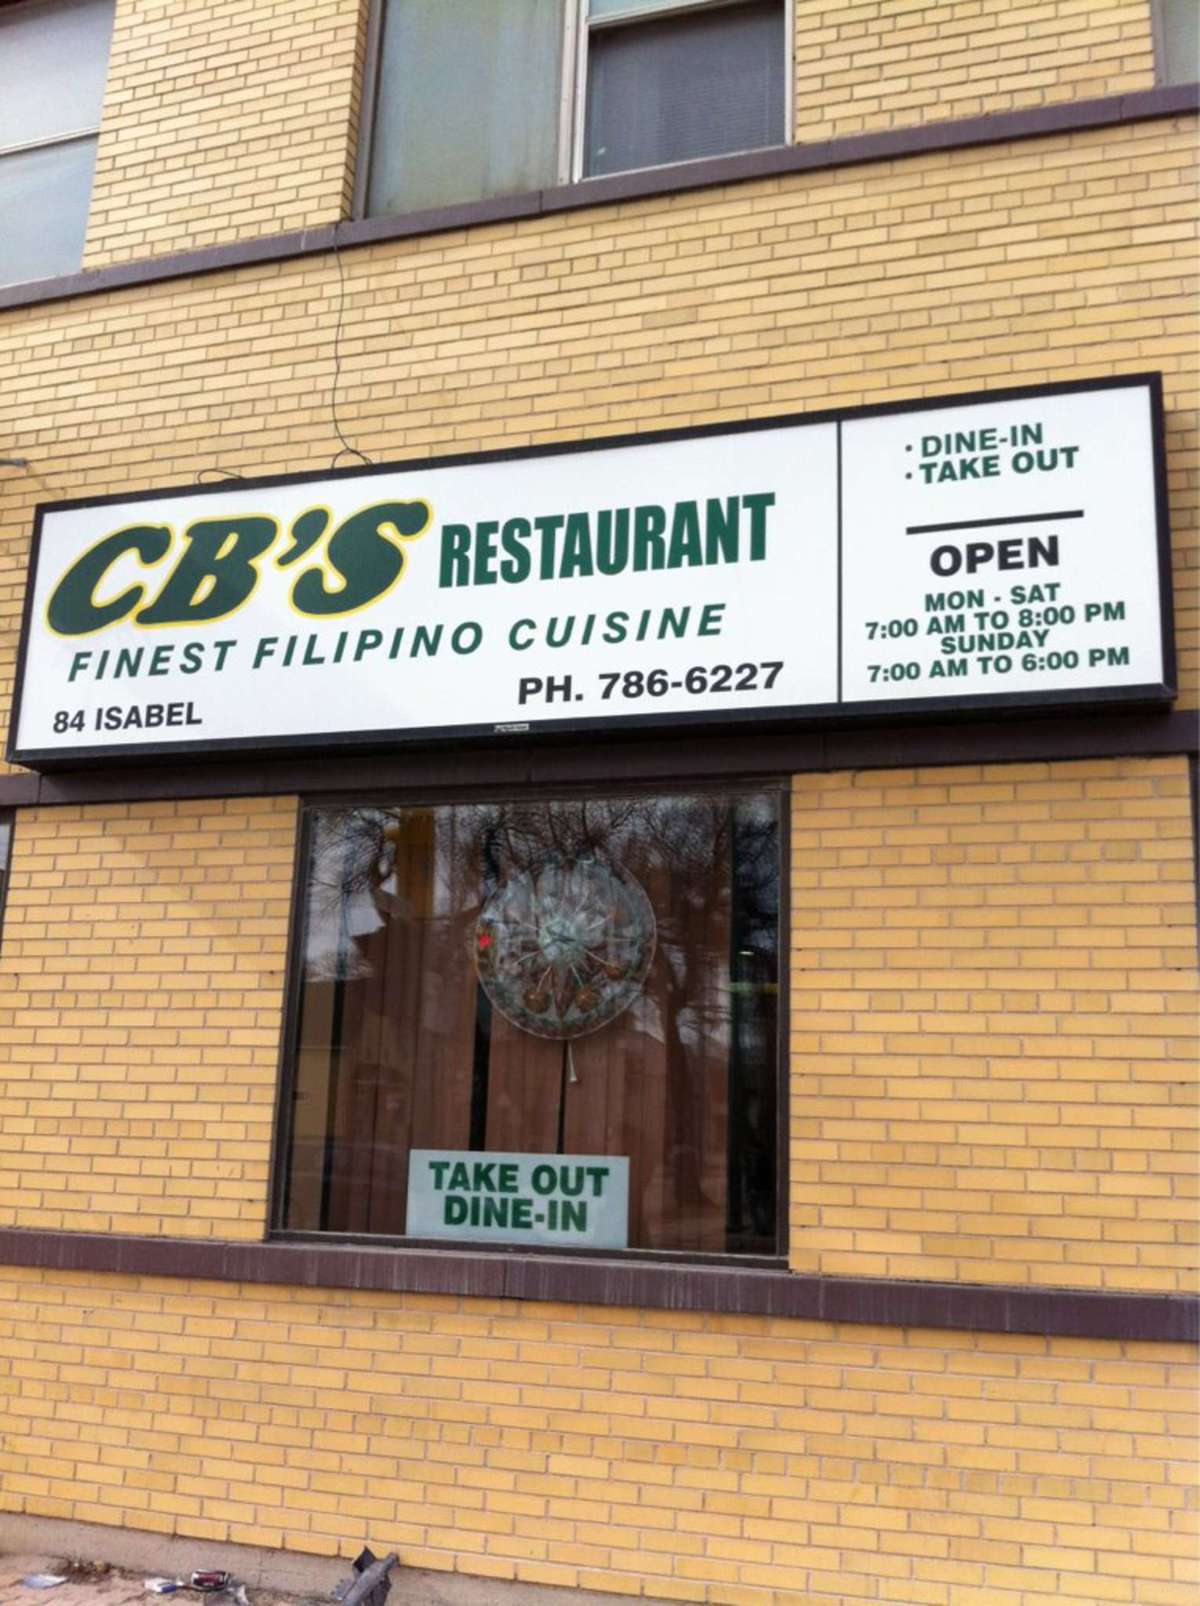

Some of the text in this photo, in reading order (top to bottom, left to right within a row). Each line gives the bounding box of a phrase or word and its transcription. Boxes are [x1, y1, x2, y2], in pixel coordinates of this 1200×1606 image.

[921, 423, 1043, 457] DINE-IN
[919, 446, 1079, 484] TAKE OUT
[46, 492, 776, 636] CB'S RESTAURANT
[930, 535, 1059, 577] OPEN
[925, 589, 985, 612] MON
[1010, 583, 1061, 605] SAT
[865, 601, 1126, 640] 7:00 AM TO 8:00 PM
[68, 603, 726, 682] FINEST FILIPINO CUISINE
[941, 629, 1050, 655] SUNDAY
[518, 661, 784, 705] PH. 786-6227
[867, 647, 1130, 683] 7:00 AM TO 6:00 PM
[52, 702, 203, 733] 84 ISABEL
[428, 1160, 610, 1197] TAKE OUT
[443, 1195, 587, 1232] DINE-IN
